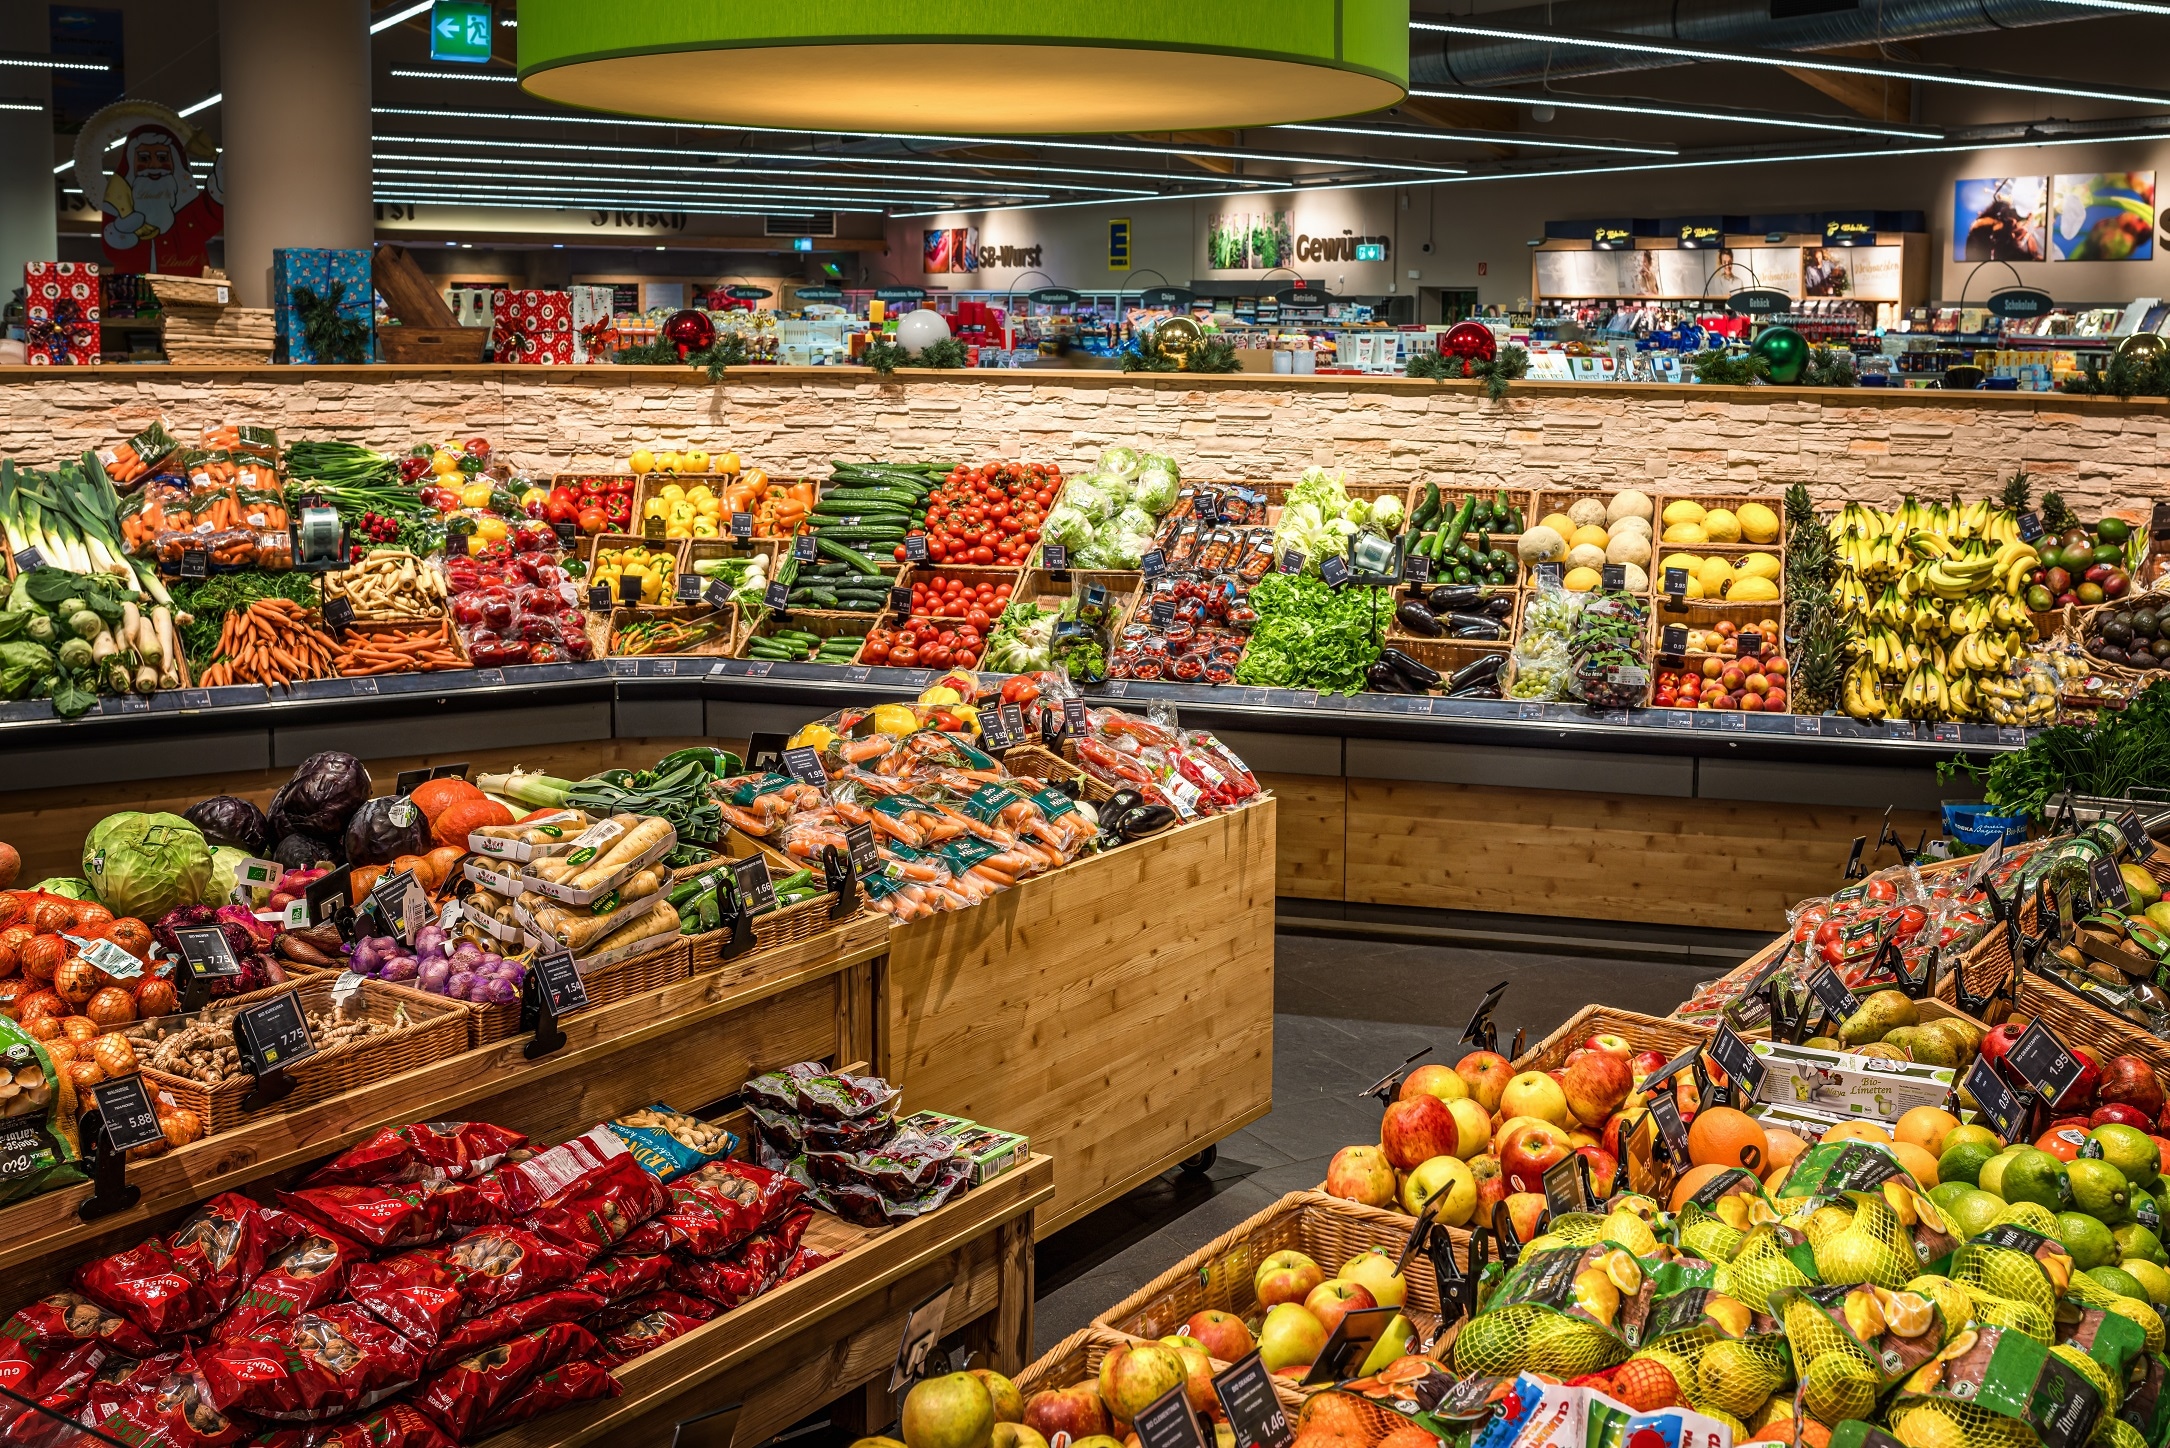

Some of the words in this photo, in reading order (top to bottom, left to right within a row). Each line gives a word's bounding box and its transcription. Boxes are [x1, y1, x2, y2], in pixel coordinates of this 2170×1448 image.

[160, 254, 197, 267] Lindt
[979, 244, 1042, 268] SB-Wurst
[1161, 293, 1176, 301] Chips
[1293, 293, 1317, 302] Getränke
[1749, 297, 1770, 307] Gebäck
[2004, 299, 2037, 310] Schokolade
[1578, 372, 1599, 380] merci
[1014, 726, 1023, 734] 1.17
[807, 770, 825, 779] 1.95
[985, 788, 1010, 805] Möhren
[2138, 833, 2149, 846] 1.95
[863, 850, 877, 863] 3.92
[958, 846, 988, 858] Möhren
[755, 882, 771, 895] 1.66
[2110, 885, 2123, 897] 2.44
[591, 887, 614, 910] Rezept
[606, 899, 615, 909] Mit
[208, 954, 231, 966] 7.75
[564, 980, 581, 994] 1.54
[1840, 992, 1855, 1009] 3.92
[1739, 1003, 1765, 1022] Tomaten
[280, 1027, 305, 1046] 7.75
[1742, 1051, 1755, 1074] 2.44
[2049, 1052, 2070, 1076] 1.95
[1861, 1077, 1882, 1086] Bio-
[1825, 1086, 1846, 1097] Naya
[1850, 1085, 1892, 1095] Limetten
[1998, 1089, 2011, 1110] 0.97
[128, 1112, 152, 1128] 5.88
[959, 1131, 973, 1141] Bio
[1677, 1133, 1688, 1148] 1.46
[2, 1138, 39, 1151] Speise-
[2, 1154, 31, 1173] Bio
[357, 1202, 403, 1211] GÜNSTIG
[1918, 1245, 1929, 1257] BIO
[1885, 1354, 1899, 1368] BIO
[1231, 1384, 1239, 1393] BIO
[1237, 1372, 1257, 1389] ORANGEN
[2047, 1373, 2067, 1403] Bio
[1956, 1384, 1971, 1395] BIO
[1145, 1421, 1154, 1431] BIO
[1152, 1401, 1181, 1426] CLEMENTINEN
[2055, 1393, 2085, 1437] Zitronen
[1261, 1411, 1286, 1438] 1.46
